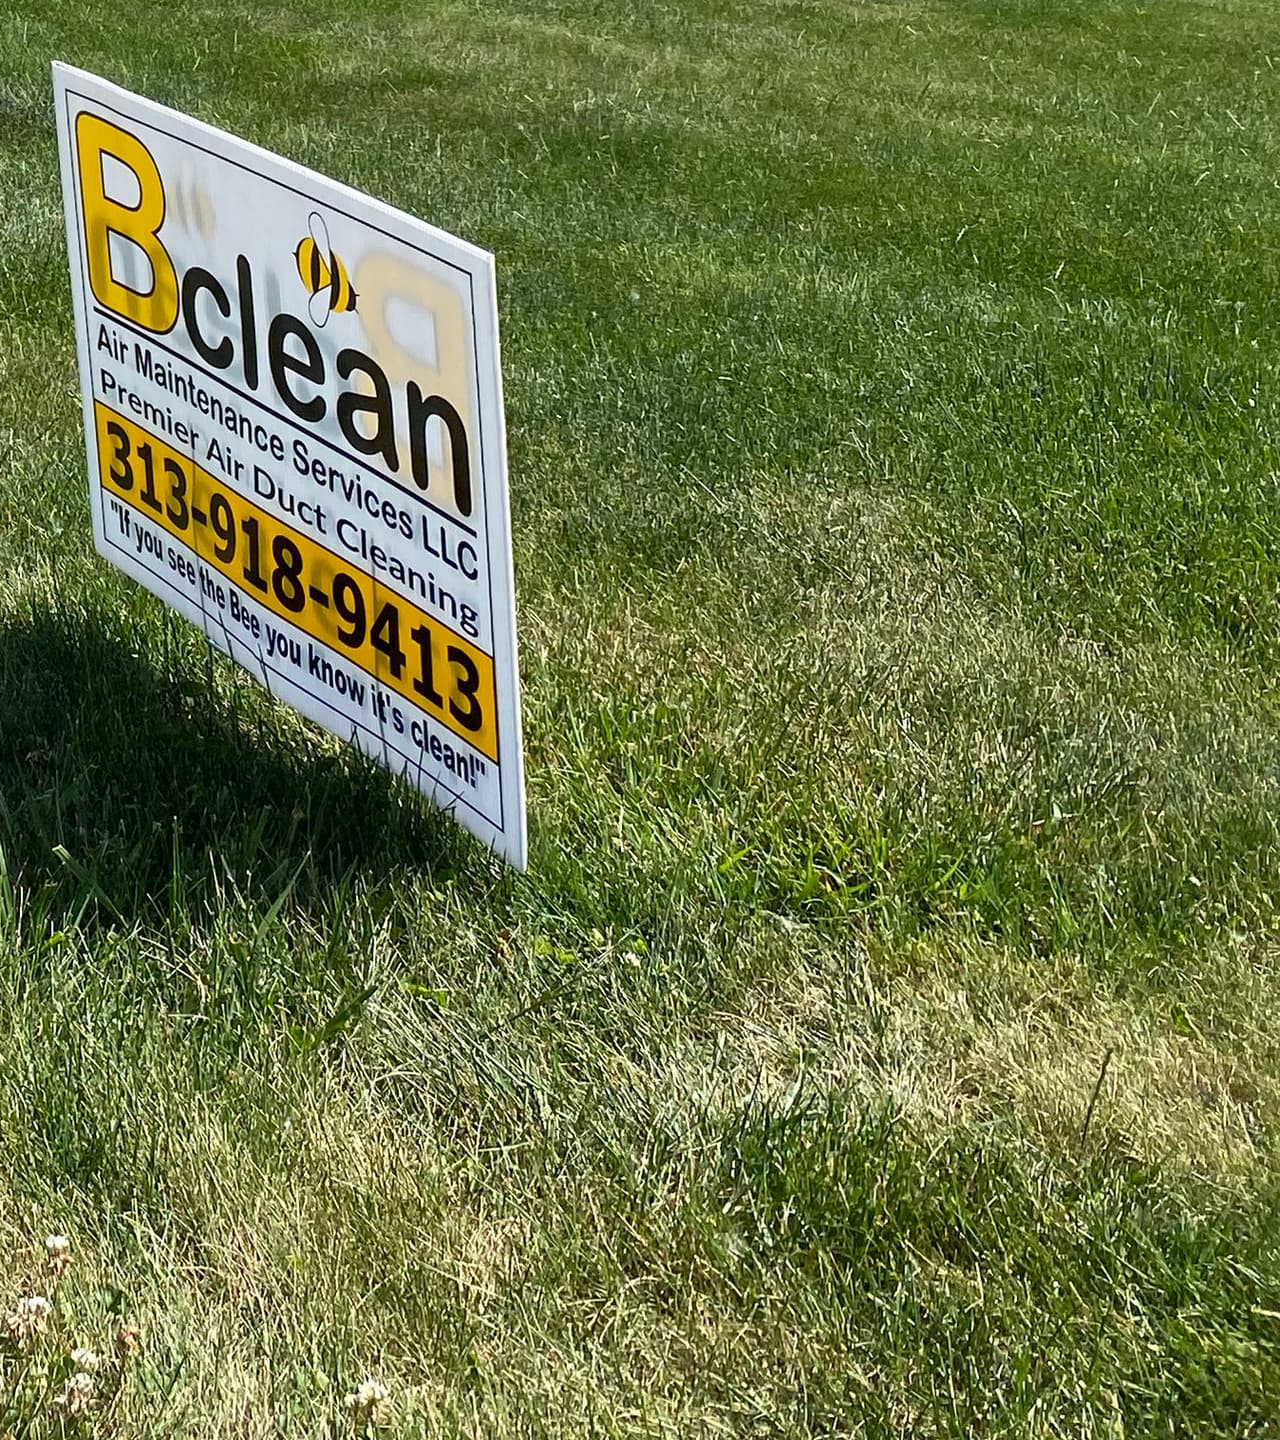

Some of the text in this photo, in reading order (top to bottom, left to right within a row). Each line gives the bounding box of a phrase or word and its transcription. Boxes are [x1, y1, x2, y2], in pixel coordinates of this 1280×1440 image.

[75, 111, 473, 517] Bclean
[98, 324, 478, 581] Air Maintenance Services LLC
[100, 368, 478, 638] Premier Air Duct Cleaning
[107, 421, 483, 732] 313-918-9413
[110, 500, 486, 788] "If you see the Bee you know it's clean!"
